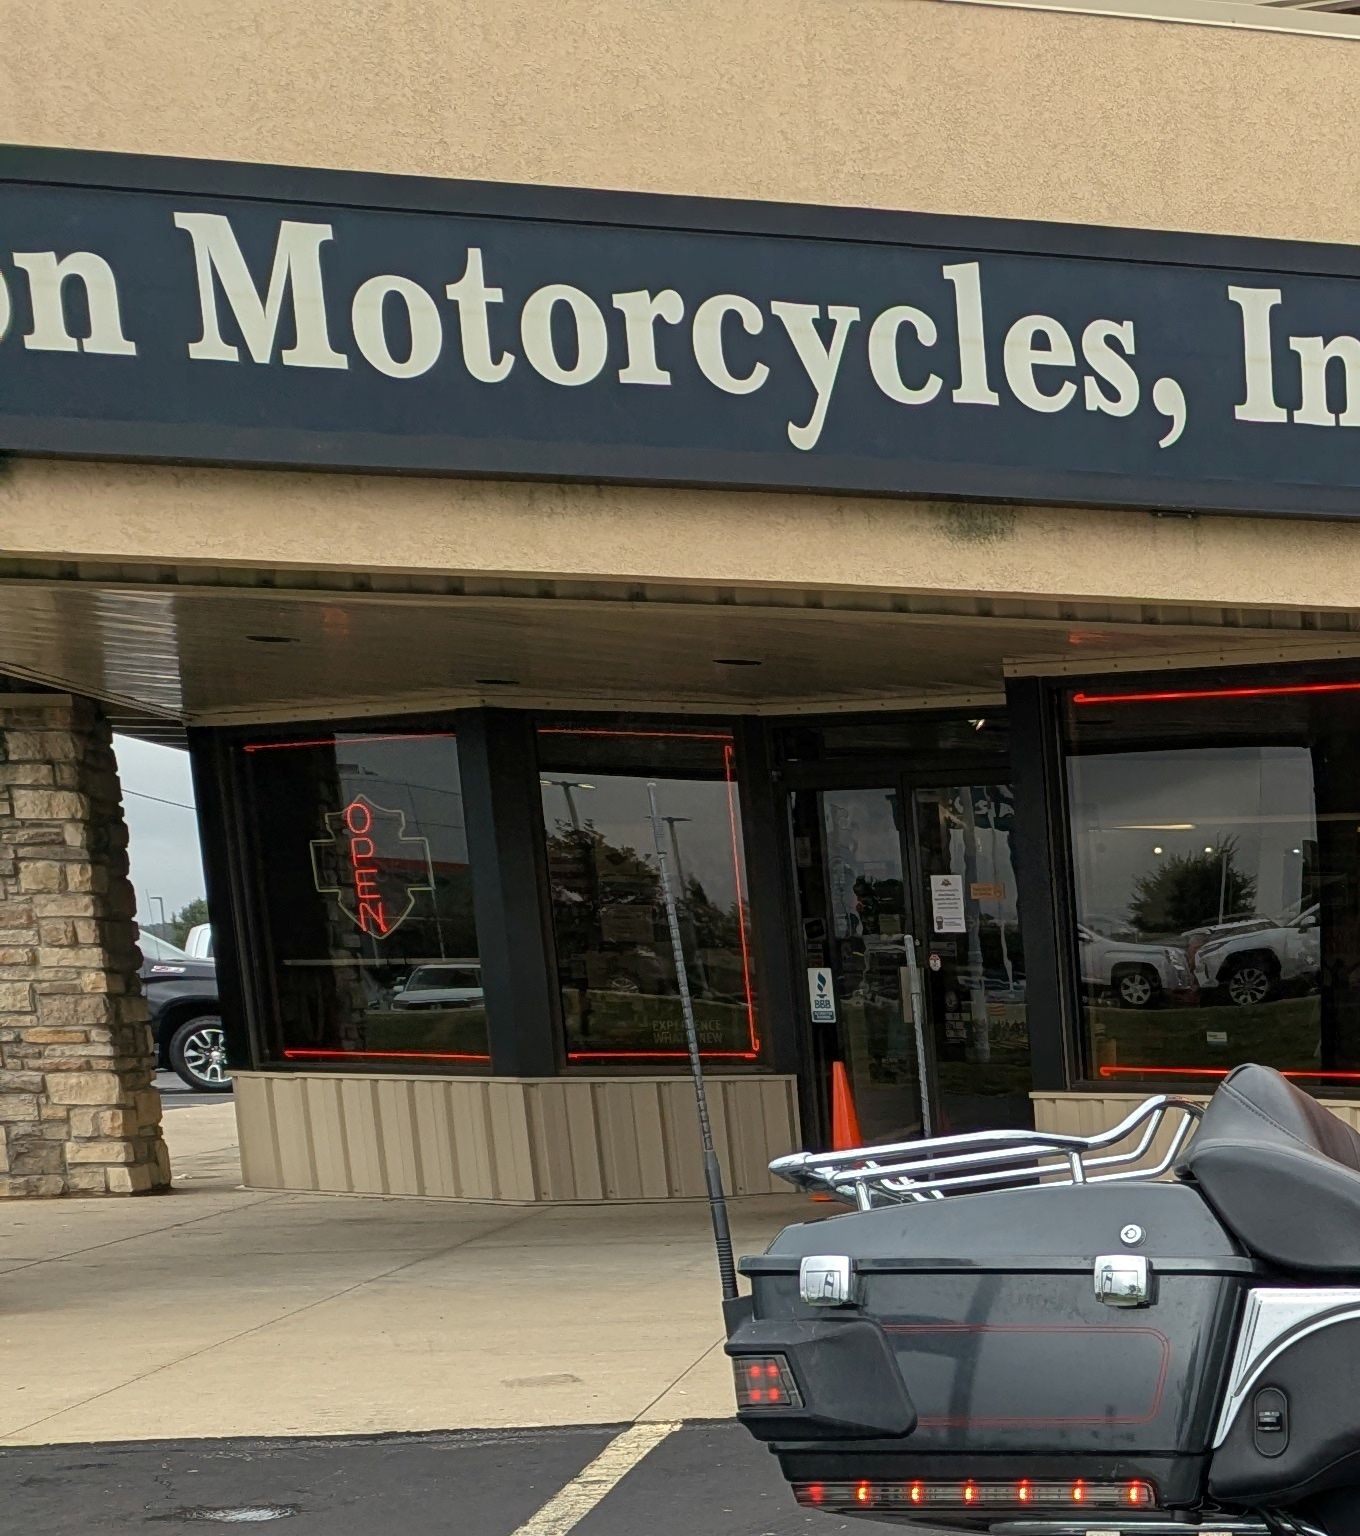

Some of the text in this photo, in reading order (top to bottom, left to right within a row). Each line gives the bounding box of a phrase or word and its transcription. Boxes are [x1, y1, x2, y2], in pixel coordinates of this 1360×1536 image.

[174, 211, 1187, 451] Motorcycles,
[346, 802, 389, 933] OPEN
[814, 999, 832, 1009] BBB
